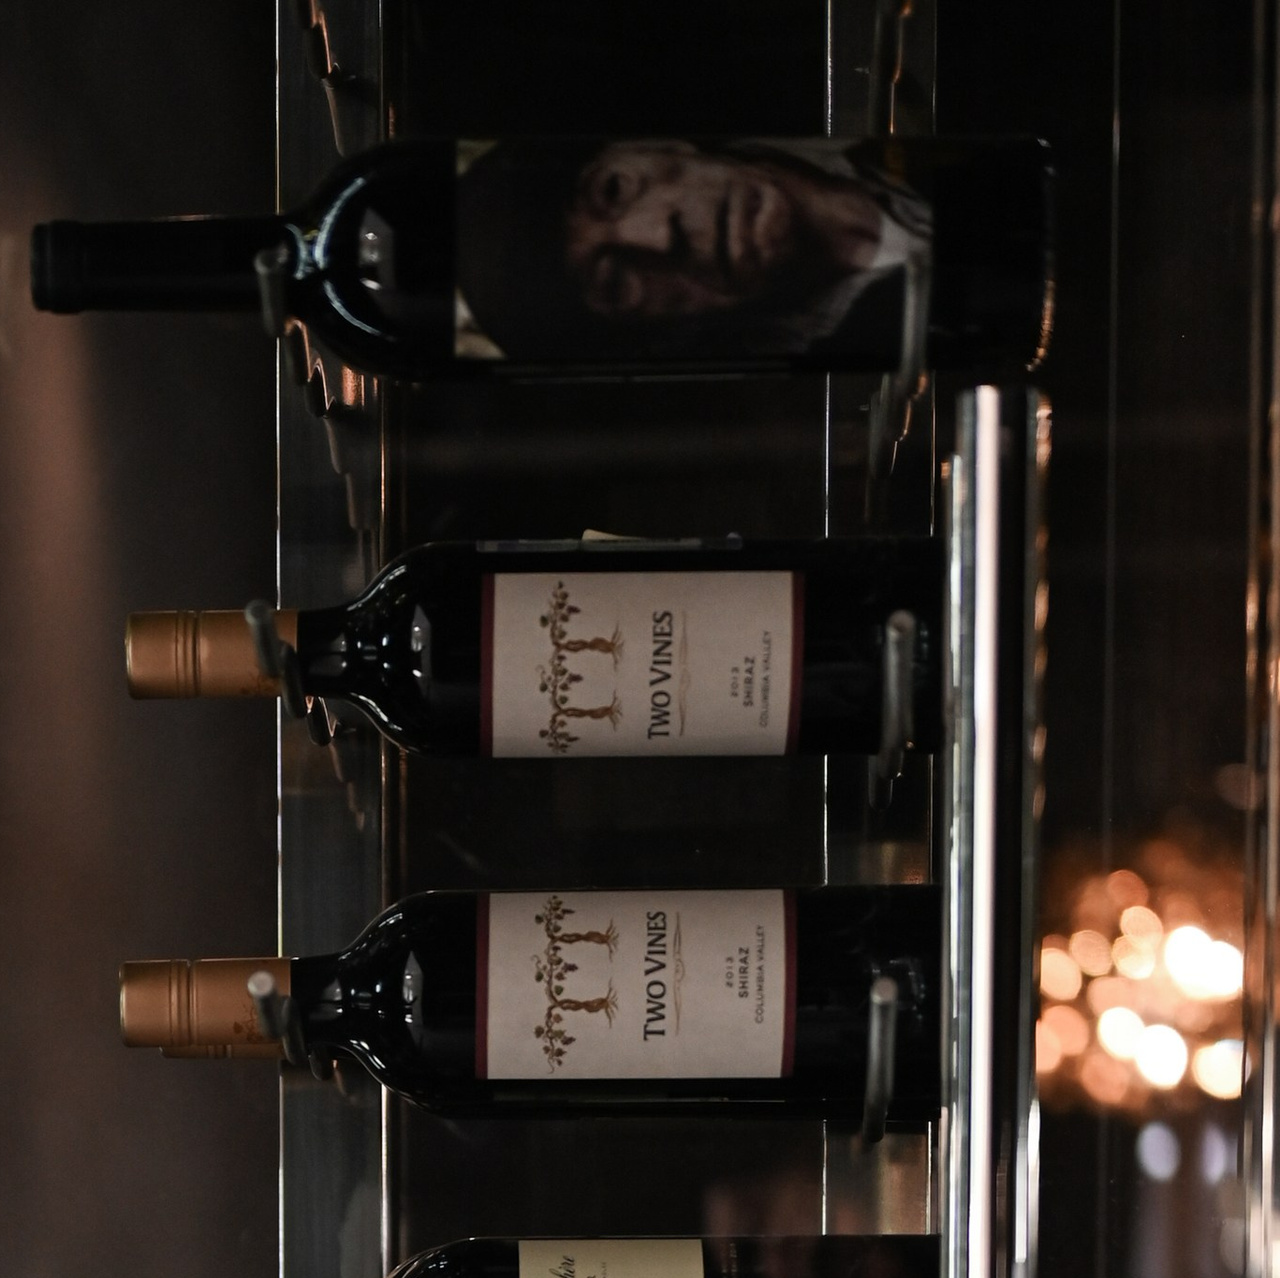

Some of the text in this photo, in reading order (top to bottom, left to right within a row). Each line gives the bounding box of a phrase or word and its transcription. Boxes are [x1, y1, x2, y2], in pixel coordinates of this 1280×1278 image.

[647, 609, 673, 740] TWO VINES
[743, 655, 755, 708] SHIRAZ
[642, 910, 667, 1042] TWO VINES
[738, 946, 750, 999] SHIRAZ
[755, 924, 766, 1024] COLUMBIA VALLEY
